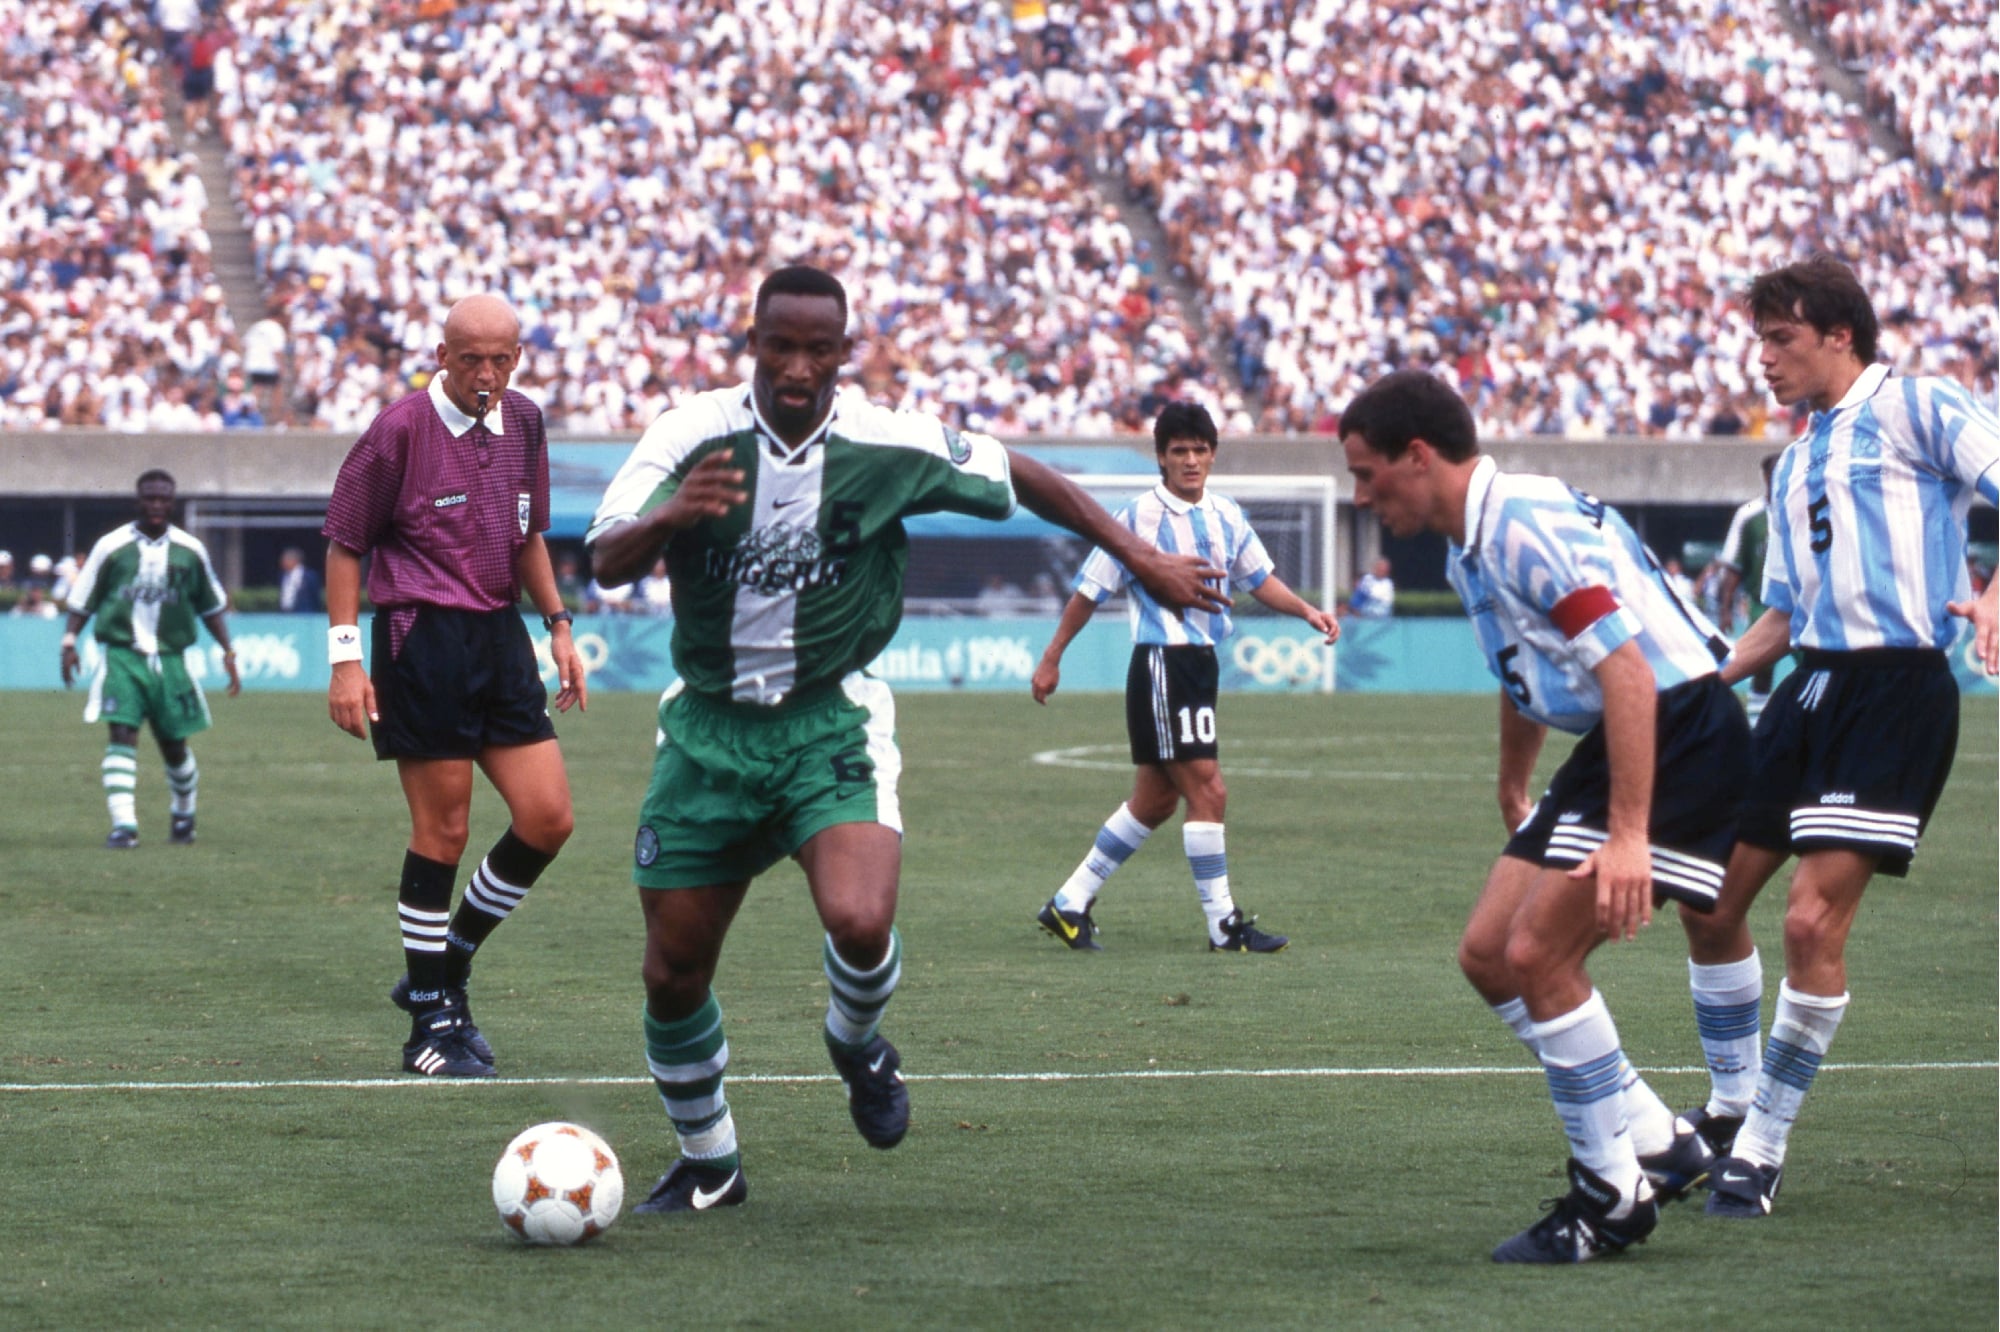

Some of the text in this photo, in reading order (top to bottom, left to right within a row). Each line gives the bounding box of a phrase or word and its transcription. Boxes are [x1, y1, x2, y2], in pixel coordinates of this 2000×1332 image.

[434, 494, 467, 507] adidas
[1808, 494, 1833, 554] 5
[825, 500, 865, 555] 5
[968, 635, 1034, 680] 1996
[1497, 643, 1532, 706] 5
[1178, 706, 1216, 744] 10
